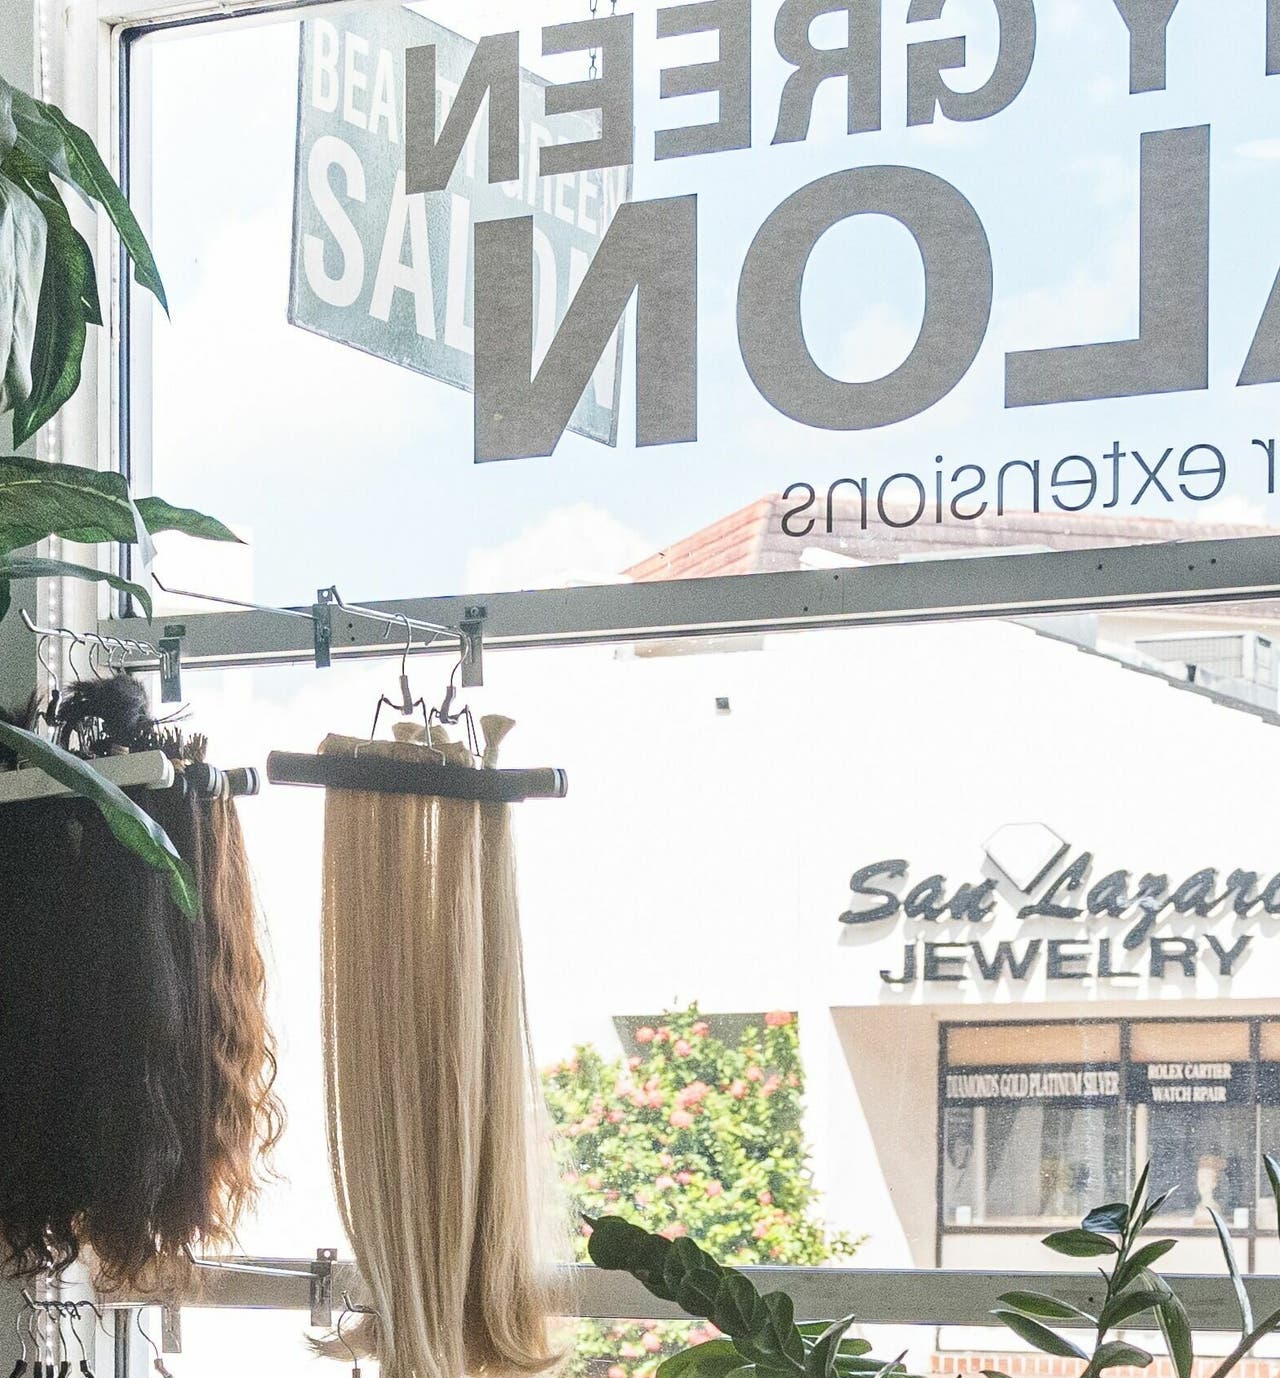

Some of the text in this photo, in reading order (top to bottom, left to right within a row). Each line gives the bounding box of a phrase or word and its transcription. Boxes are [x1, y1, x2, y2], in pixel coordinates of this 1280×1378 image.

[303, 134, 615, 411] SAL
[838, 858, 999, 924] San
[879, 934, 1252, 985] JEWELRY
[946, 1071, 1119, 1098] DIAMONDS GOLD PLATINUM SILVER
[1147, 1063, 1232, 1079] ROLEX CARTIER
[1151, 1086, 1187, 1102] WATCH
